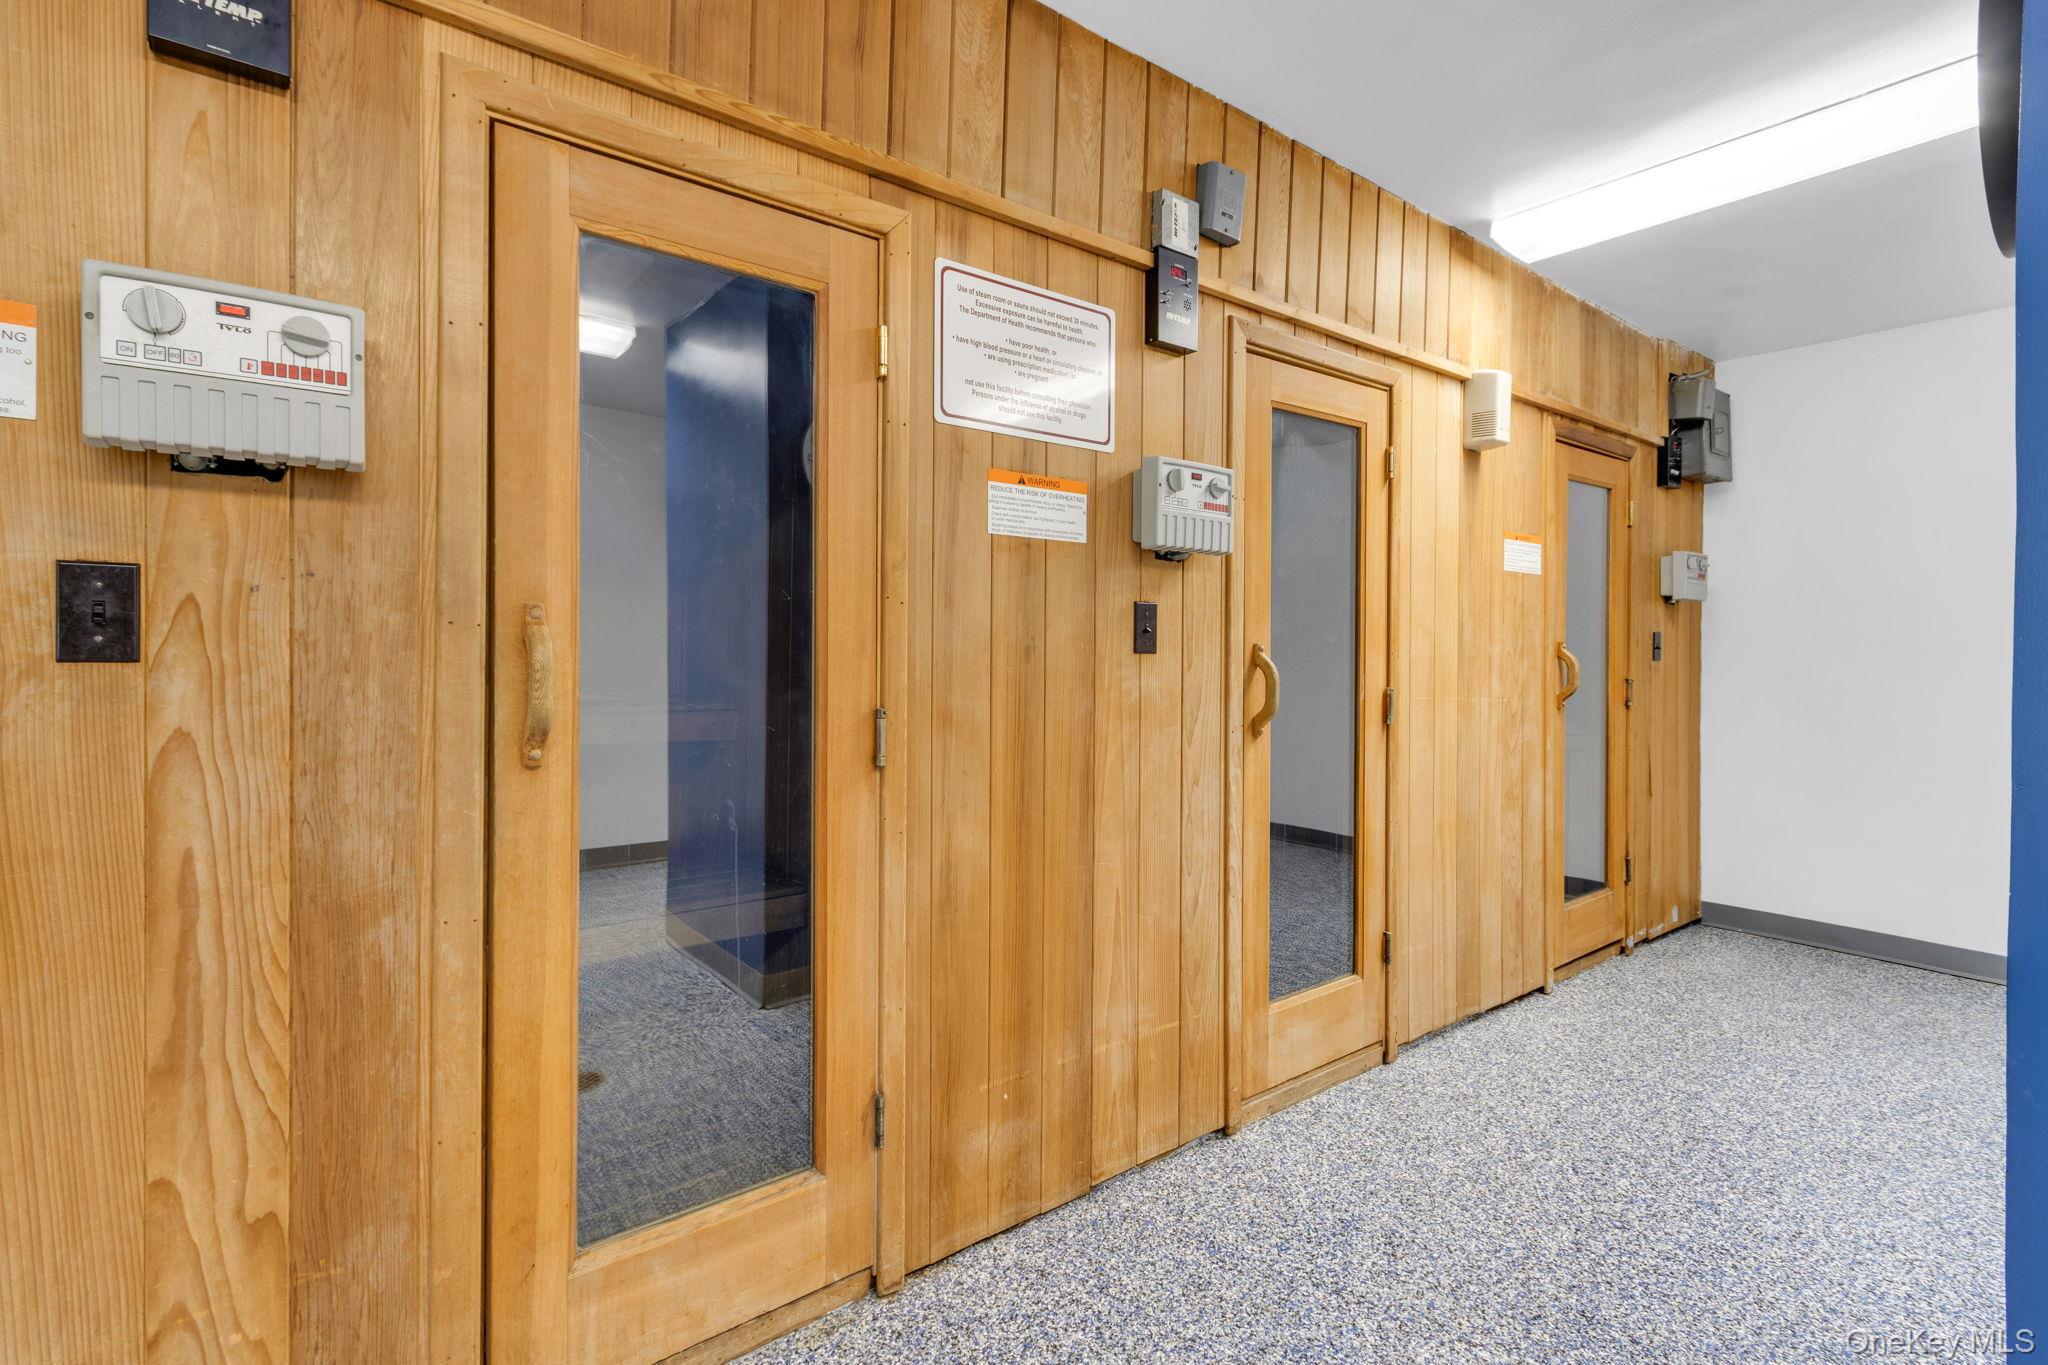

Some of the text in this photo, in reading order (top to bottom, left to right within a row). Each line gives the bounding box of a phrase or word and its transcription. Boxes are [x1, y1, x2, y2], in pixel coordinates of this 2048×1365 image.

[957, 284, 968, 293] Use
[975, 290, 992, 300] steam
[993, 295, 1006, 304] room
[1014, 301, 1029, 311] sauna
[1030, 305, 1046, 315] should
[1056, 313, 1072, 323] exceed
[975, 299, 1001, 313] Excessive
[1002, 307, 1026, 320] exposure
[1044, 319, 1062, 328] harmful
[959, 304, 970, 314] The
[970, 307, 1001, 322] Department
[1002, 316, 1007, 324] of
[1008, 318, 1024, 328] Health
[1024, 324, 1056, 338] recommends
[1057, 331, 1067, 340] that
[1067, 336, 1086, 346] persons
[6, 346, 22, 355] too
[120, 344, 134, 353] ON
[146, 348, 165, 357] OFF
[955, 334, 969, 344] have
[970, 339, 982, 349] high
[983, 341, 998, 352] blood
[999, 346, 1021, 358] pressure
[1033, 353, 1046, 363] heart
[1009, 338, 1020, 347] have
[1021, 342, 1034, 351] poor
[987, 353, 996, 361] are
[997, 356, 1011, 367] using
[1012, 359, 1041, 372] prescription
[1026, 372, 1048, 383] pregnant
[965, 378, 974, 386] not
[975, 381, 985, 389] use
[985, 383, 996, 391] this
[997, 384, 1013, 396] facility
[1014, 388, 1030, 398] before
[972, 388, 994, 400] Persons
[994, 394, 1009, 403] under
[1042, 403, 1048, 411] of
[1073, 410, 1087, 420] drugs
[1016, 409, 1025, 417] not
[1036, 411, 1045, 420] this
[1028, 477, 1061, 489] WARNING
[991, 484, 1014, 494] REDUCE
[1015, 487, 1025, 495] THE
[1048, 492, 1085, 504] OVERHEATING
